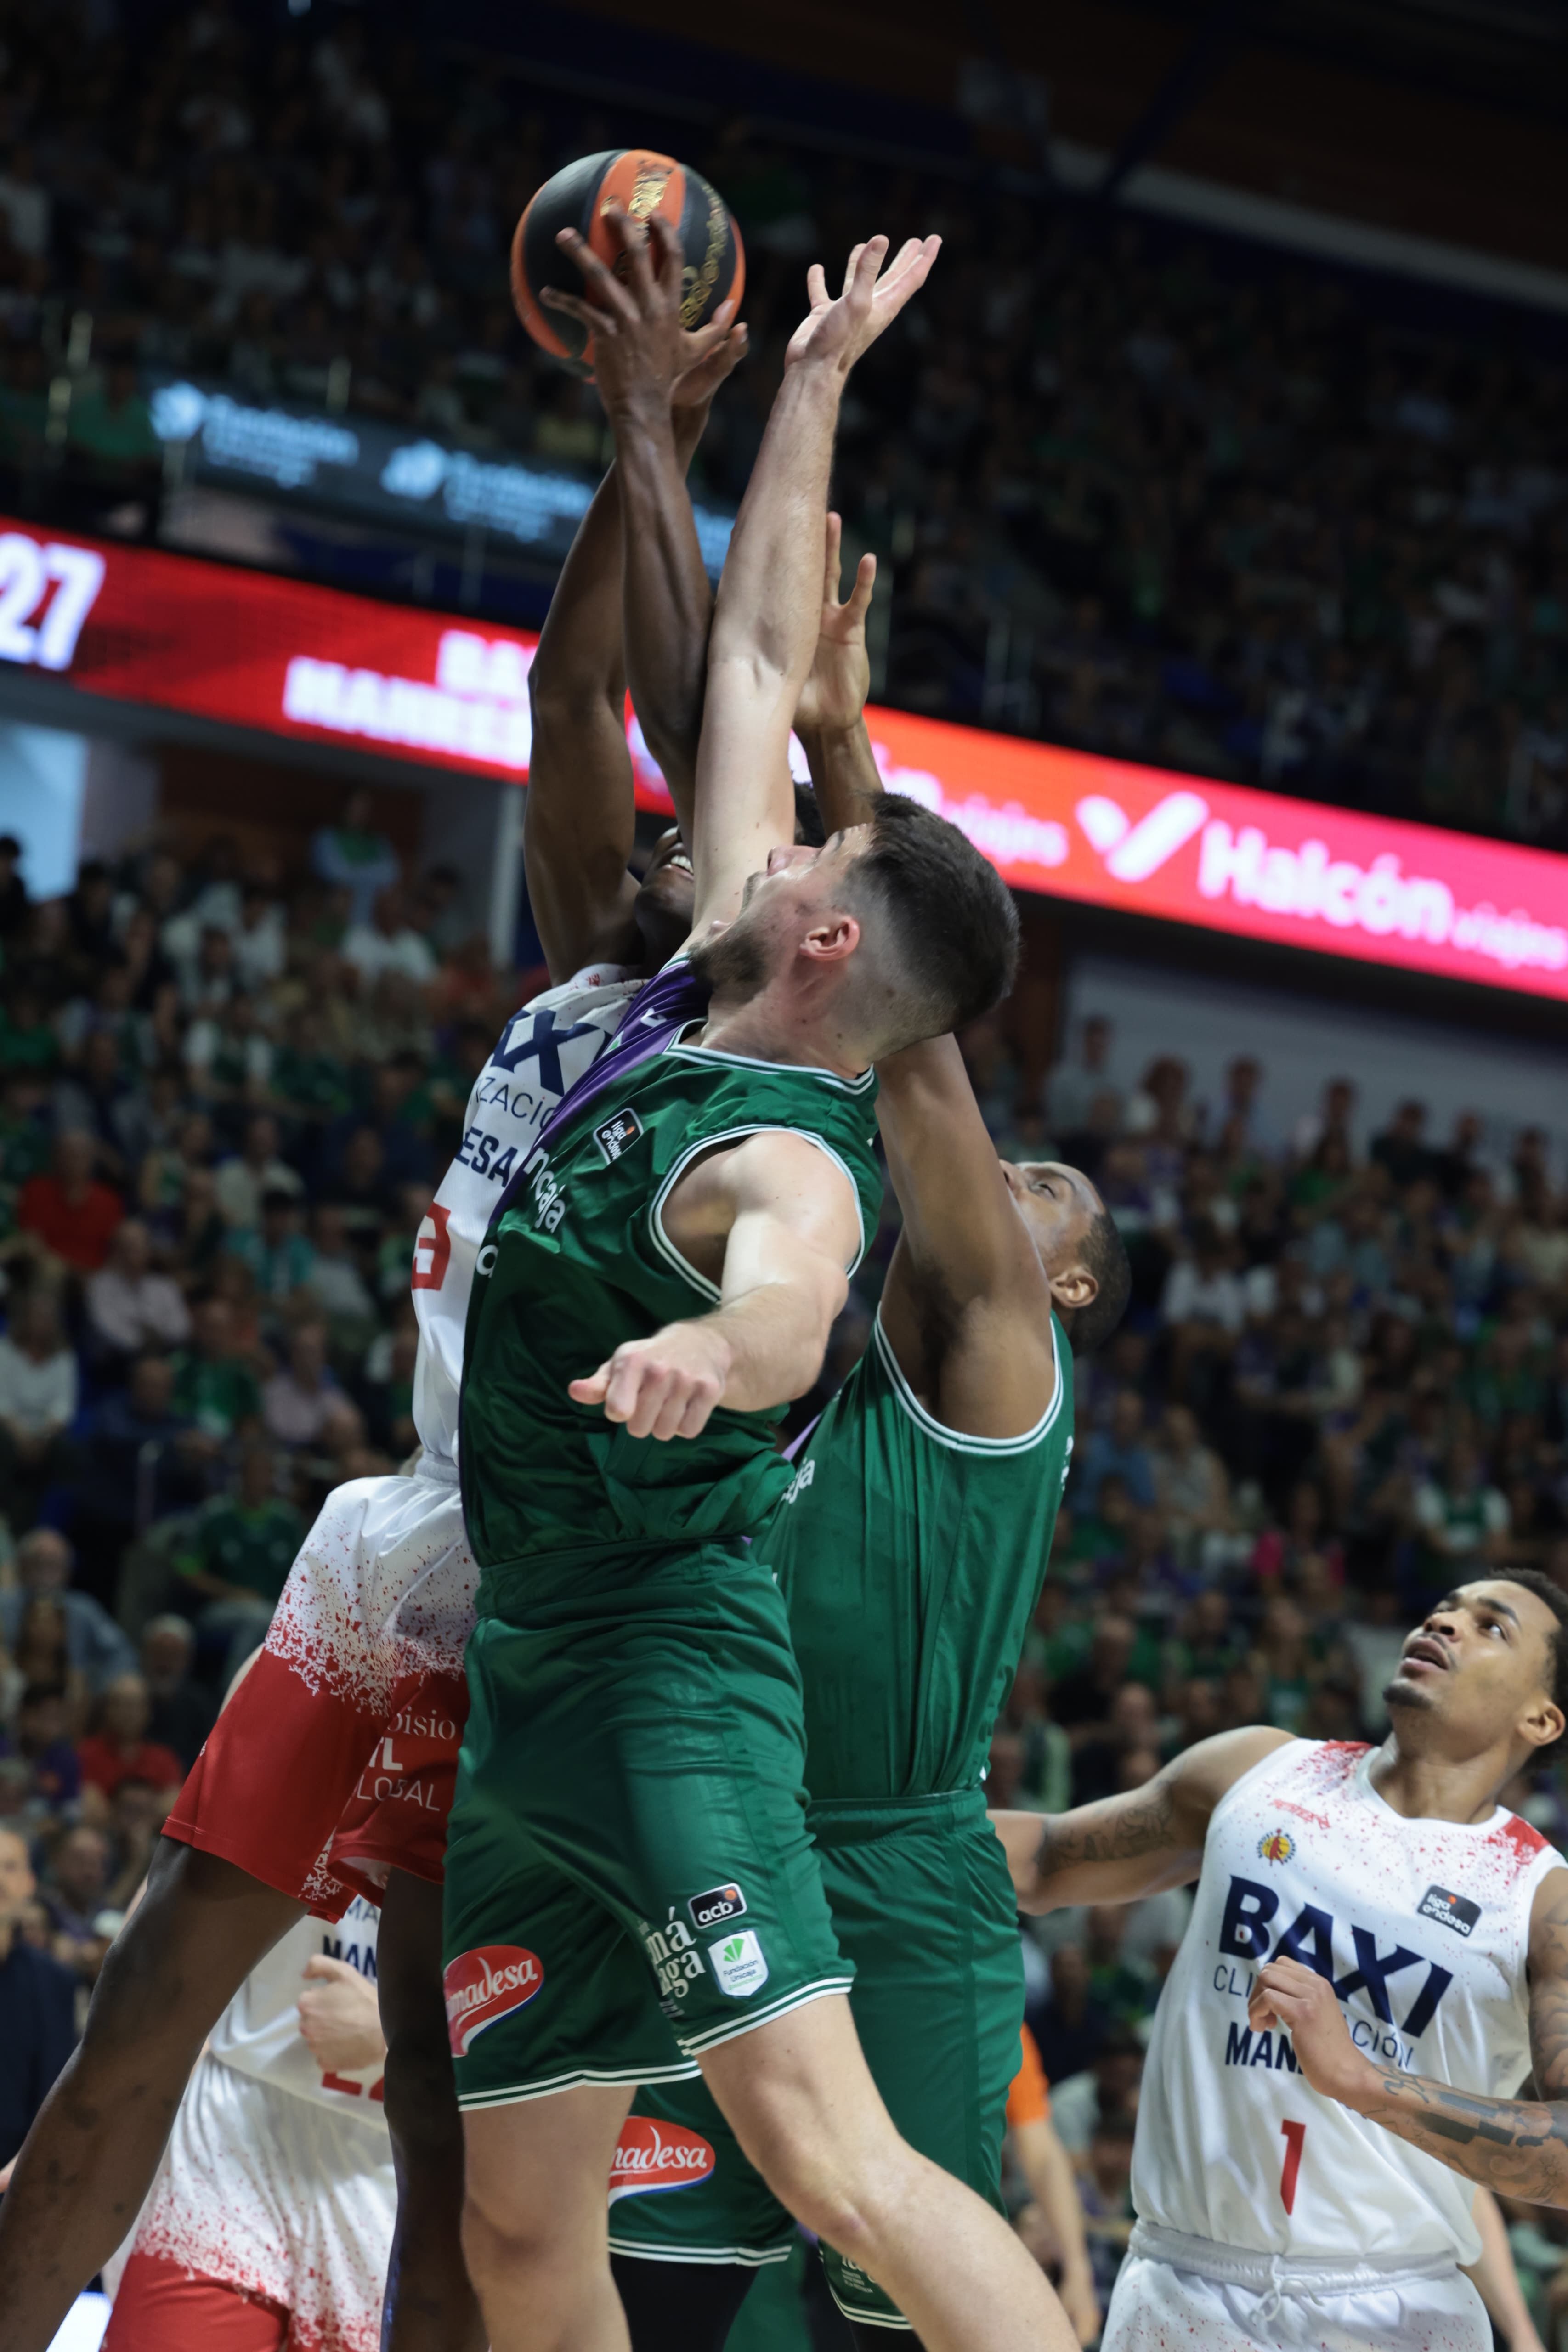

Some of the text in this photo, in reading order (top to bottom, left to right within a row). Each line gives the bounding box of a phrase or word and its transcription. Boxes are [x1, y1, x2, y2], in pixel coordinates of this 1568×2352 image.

[0, 532, 106, 672] 27
[1198, 820, 1455, 944] Halcón
[698, 1900, 734, 1923] acb
[1422, 1903, 1471, 1935] endesa
[1427, 1893, 1451, 1911] liga
[1218, 1874, 1453, 2039] BAXI
[1280, 2118, 1306, 2216] 1
